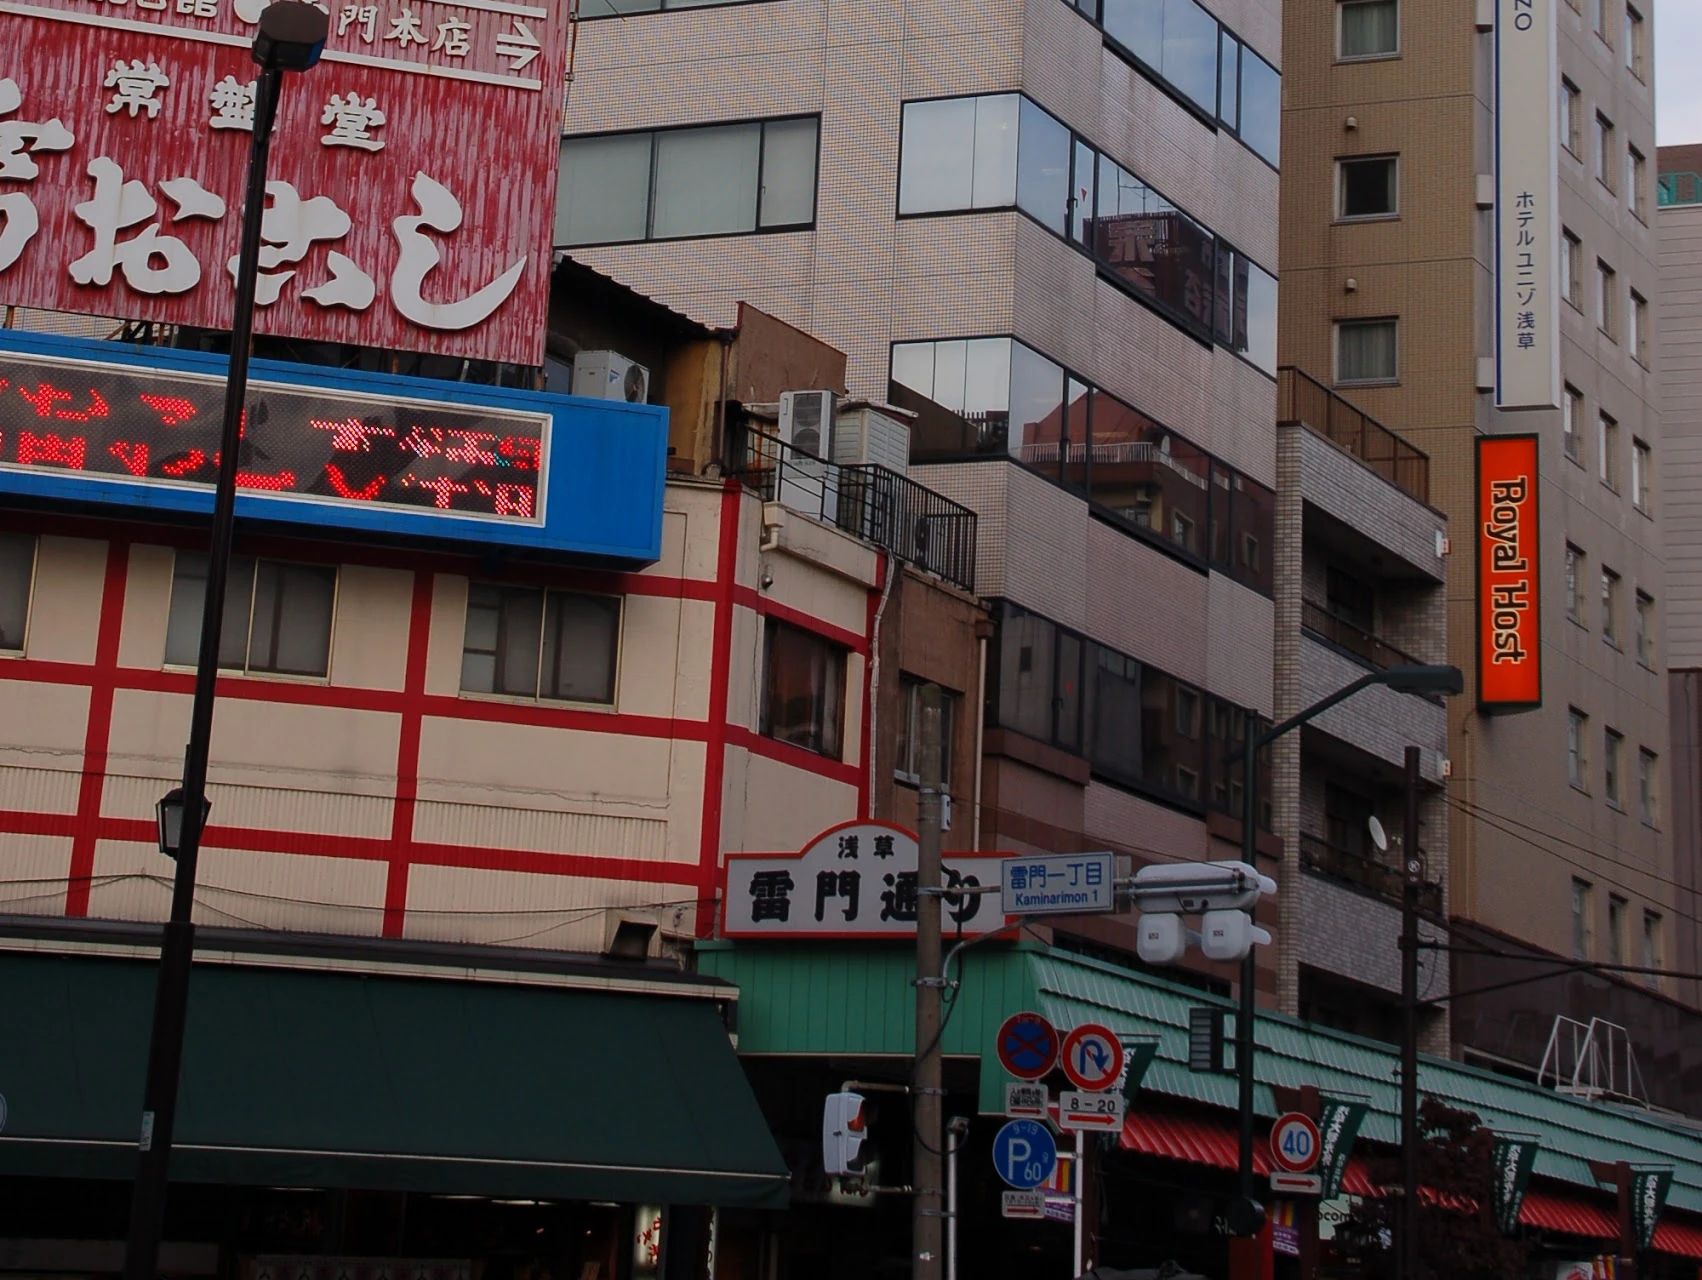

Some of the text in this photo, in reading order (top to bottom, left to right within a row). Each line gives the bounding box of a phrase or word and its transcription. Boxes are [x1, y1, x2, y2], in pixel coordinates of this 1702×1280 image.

[104, 59, 387, 152] 常盤堂
[1516, 191, 1537, 350] ホテルユニゾ浅草
[1485, 475, 1528, 665] Royal Host
[838, 835, 895, 860] 浅草
[748, 869, 981, 922] 雷門通り
[1010, 862, 1102, 889] 雷門一丁目
[1015, 890, 1088, 906] Kaminarimon
[1008, 1138, 1031, 1180] P
[1283, 1130, 1310, 1156] 40
